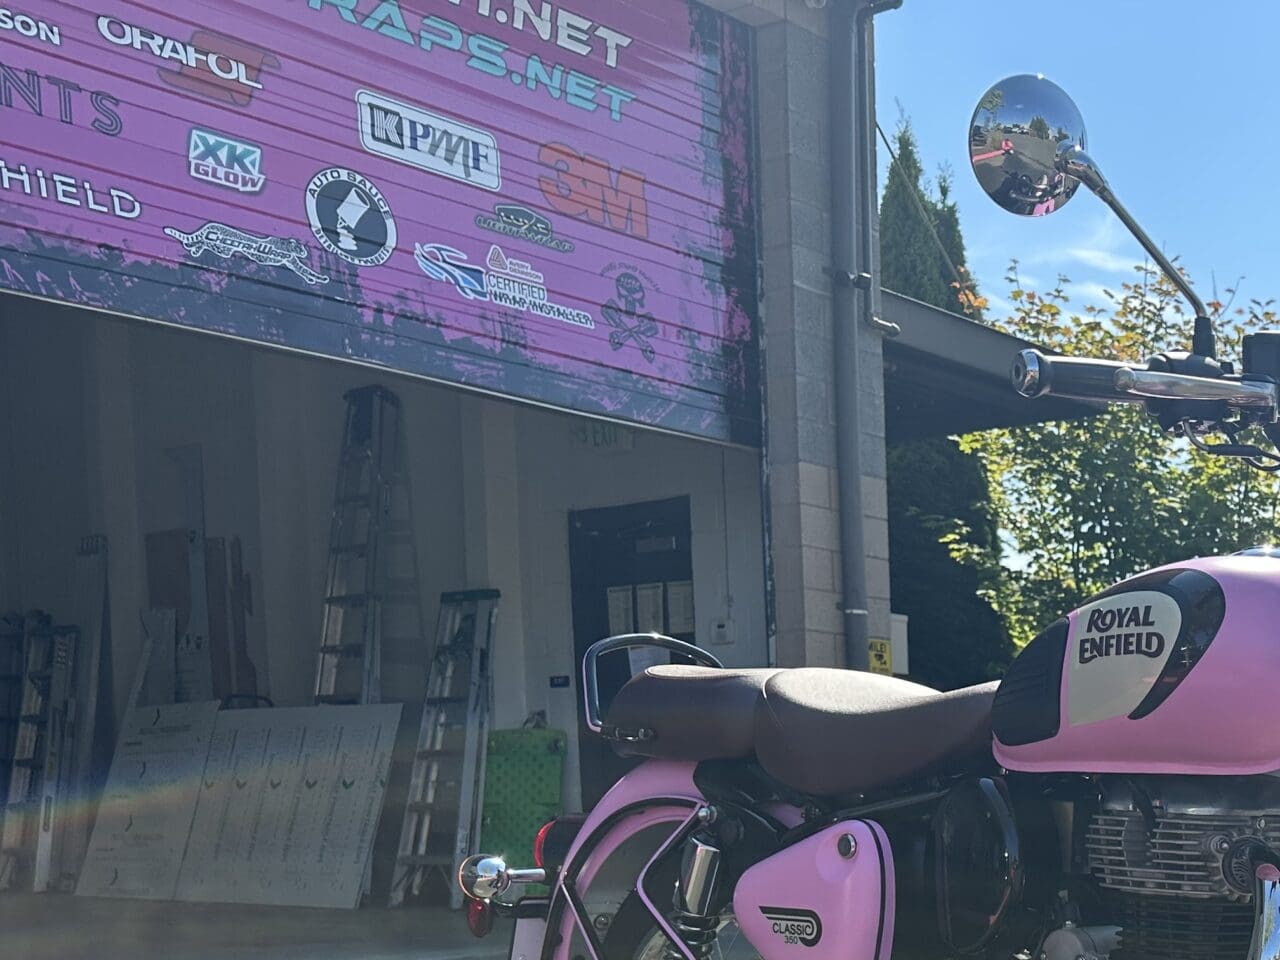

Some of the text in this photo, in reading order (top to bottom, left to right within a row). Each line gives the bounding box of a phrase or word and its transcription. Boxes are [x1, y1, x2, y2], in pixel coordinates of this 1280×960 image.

[96, 15, 263, 89] ORAFOL
[194, 162, 261, 188] GLOW
[538, 142, 648, 239] 3M
[308, 169, 393, 221] AUTO SAUCE
[487, 273, 546, 303] CERTIFIED
[489, 289, 593, 327] WRAP INSTALLER
[1086, 605, 1155, 633] ROYAL
[1079, 632, 1165, 664] ENFIELD
[772, 922, 814, 936] CLASSIC
[784, 936, 798, 944] 350
